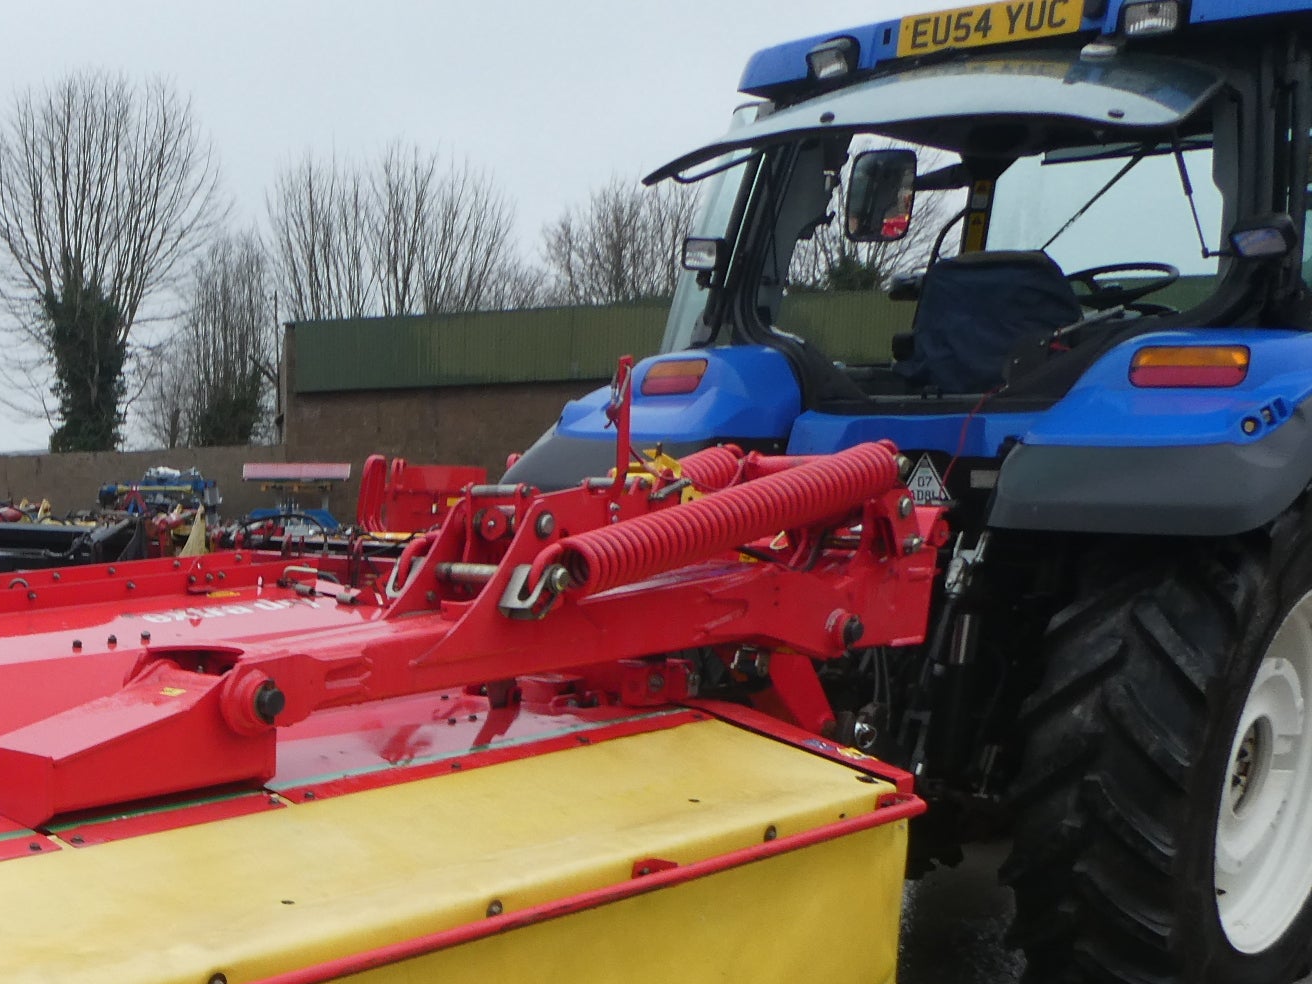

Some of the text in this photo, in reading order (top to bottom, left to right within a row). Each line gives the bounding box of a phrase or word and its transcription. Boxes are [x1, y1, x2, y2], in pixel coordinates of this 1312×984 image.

[911, 0, 1069, 49] EU54 YUC
[917, 476, 932, 487] 07
